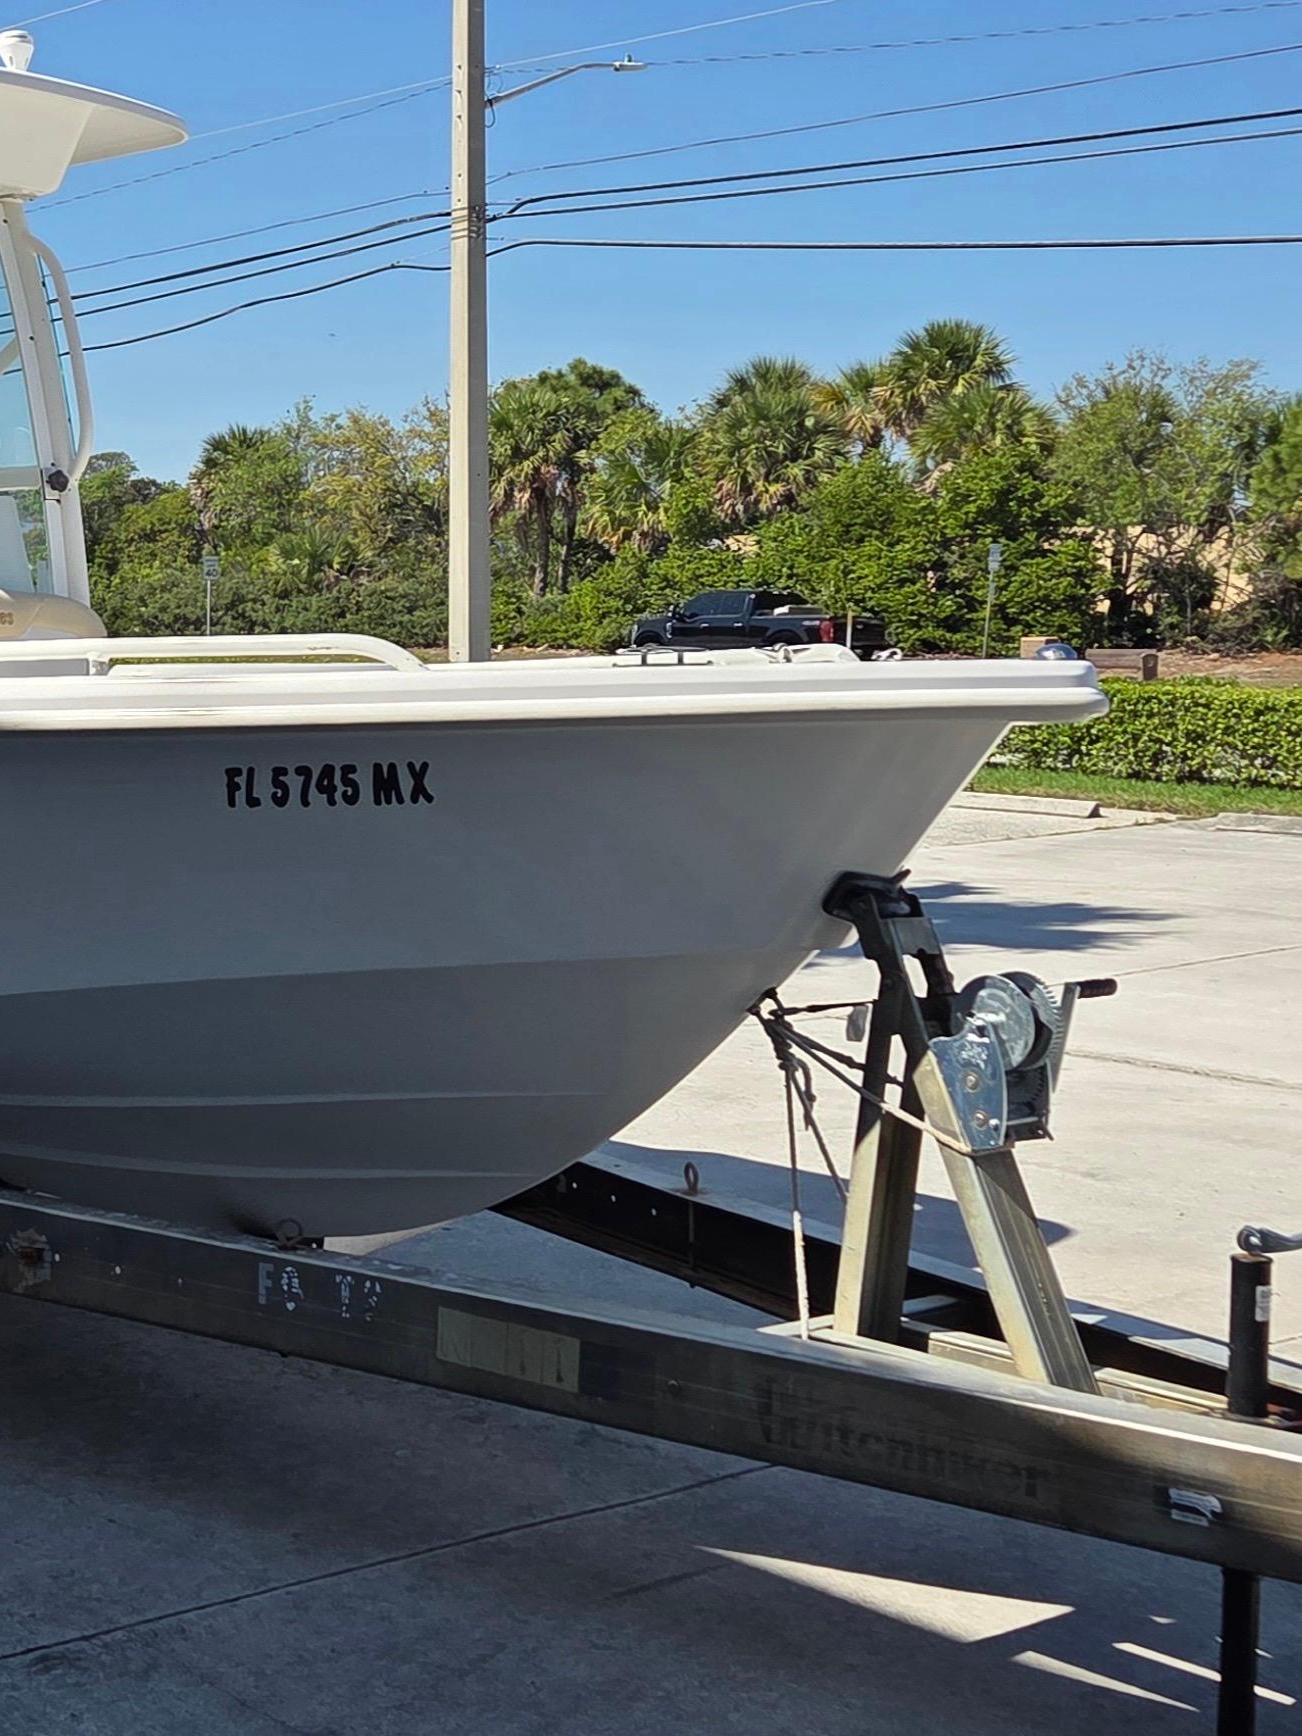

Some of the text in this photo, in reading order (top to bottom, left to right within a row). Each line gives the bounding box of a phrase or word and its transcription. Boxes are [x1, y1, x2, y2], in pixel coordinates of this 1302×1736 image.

[225, 761, 435, 808] FL 5745 MX
